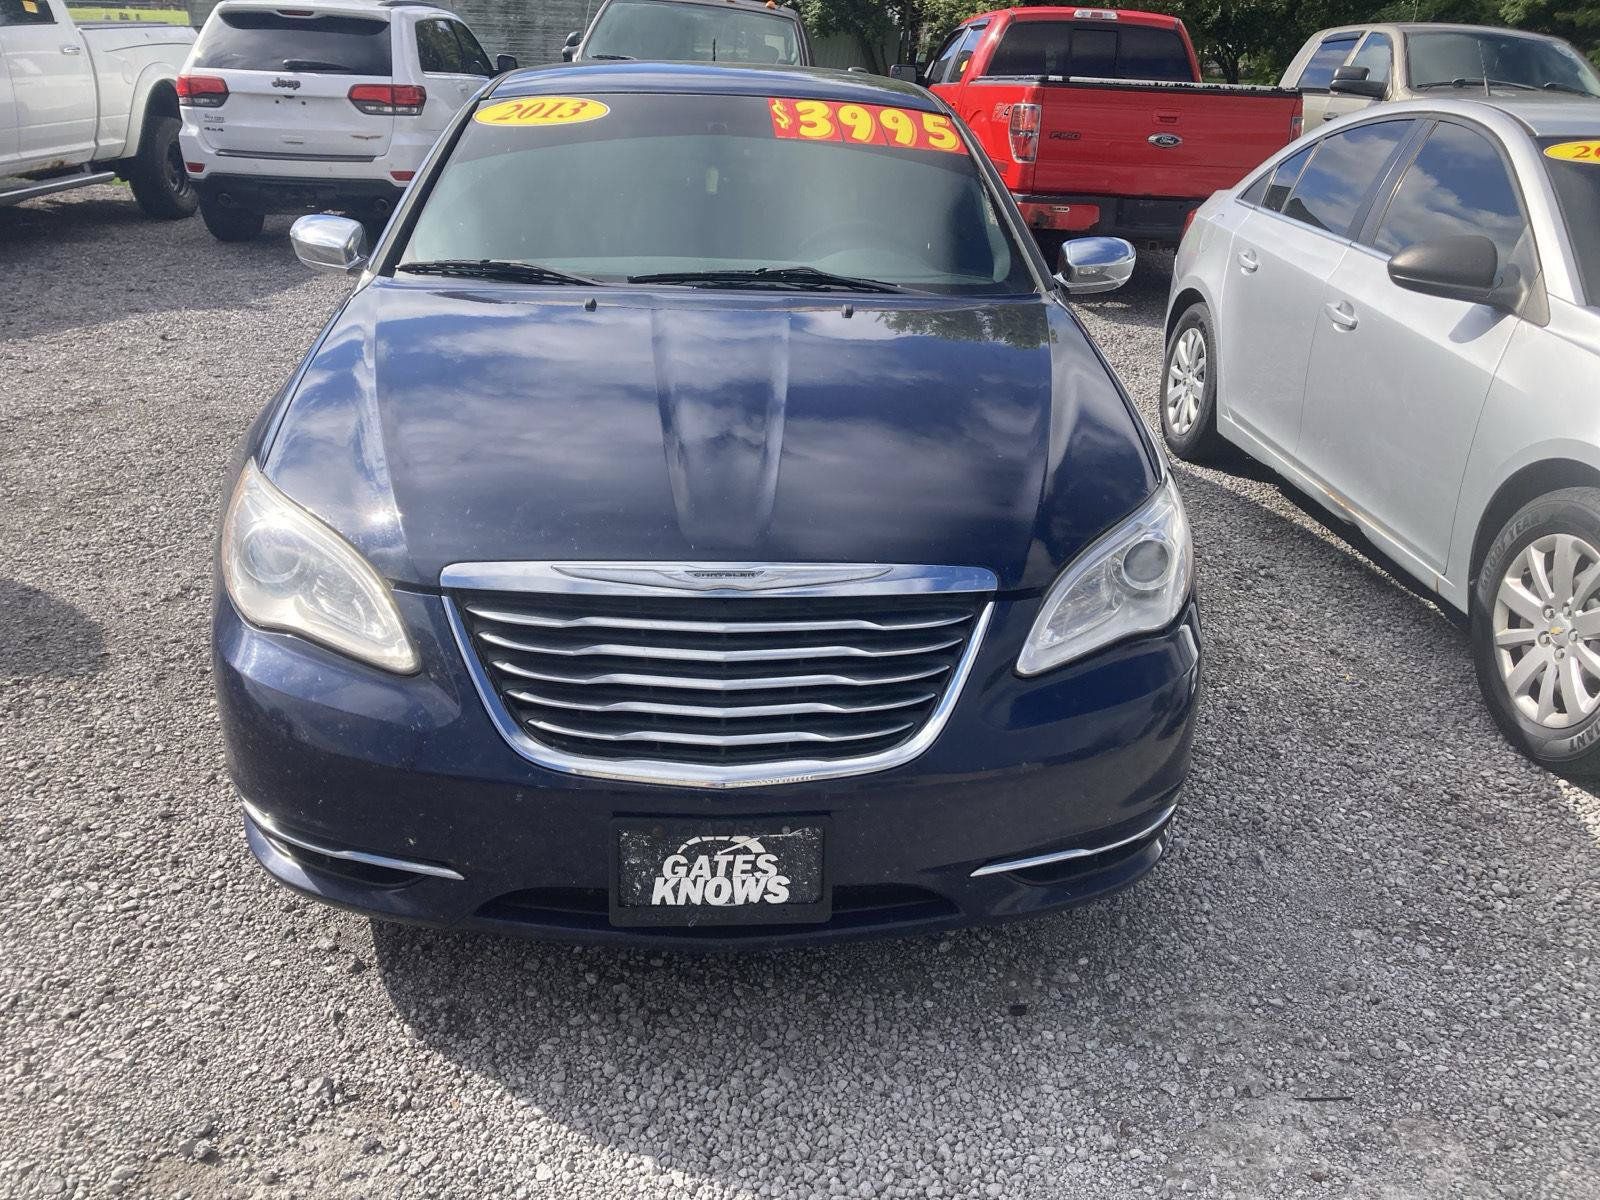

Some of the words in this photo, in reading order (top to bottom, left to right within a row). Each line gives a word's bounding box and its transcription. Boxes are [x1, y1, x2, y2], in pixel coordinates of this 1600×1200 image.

[271, 77, 301, 91] Jeep
[492, 101, 588, 121] 2013
[772, 100, 960, 151] $3995
[662, 854, 779, 880] GATES
[651, 875, 791, 906] KNOWS
